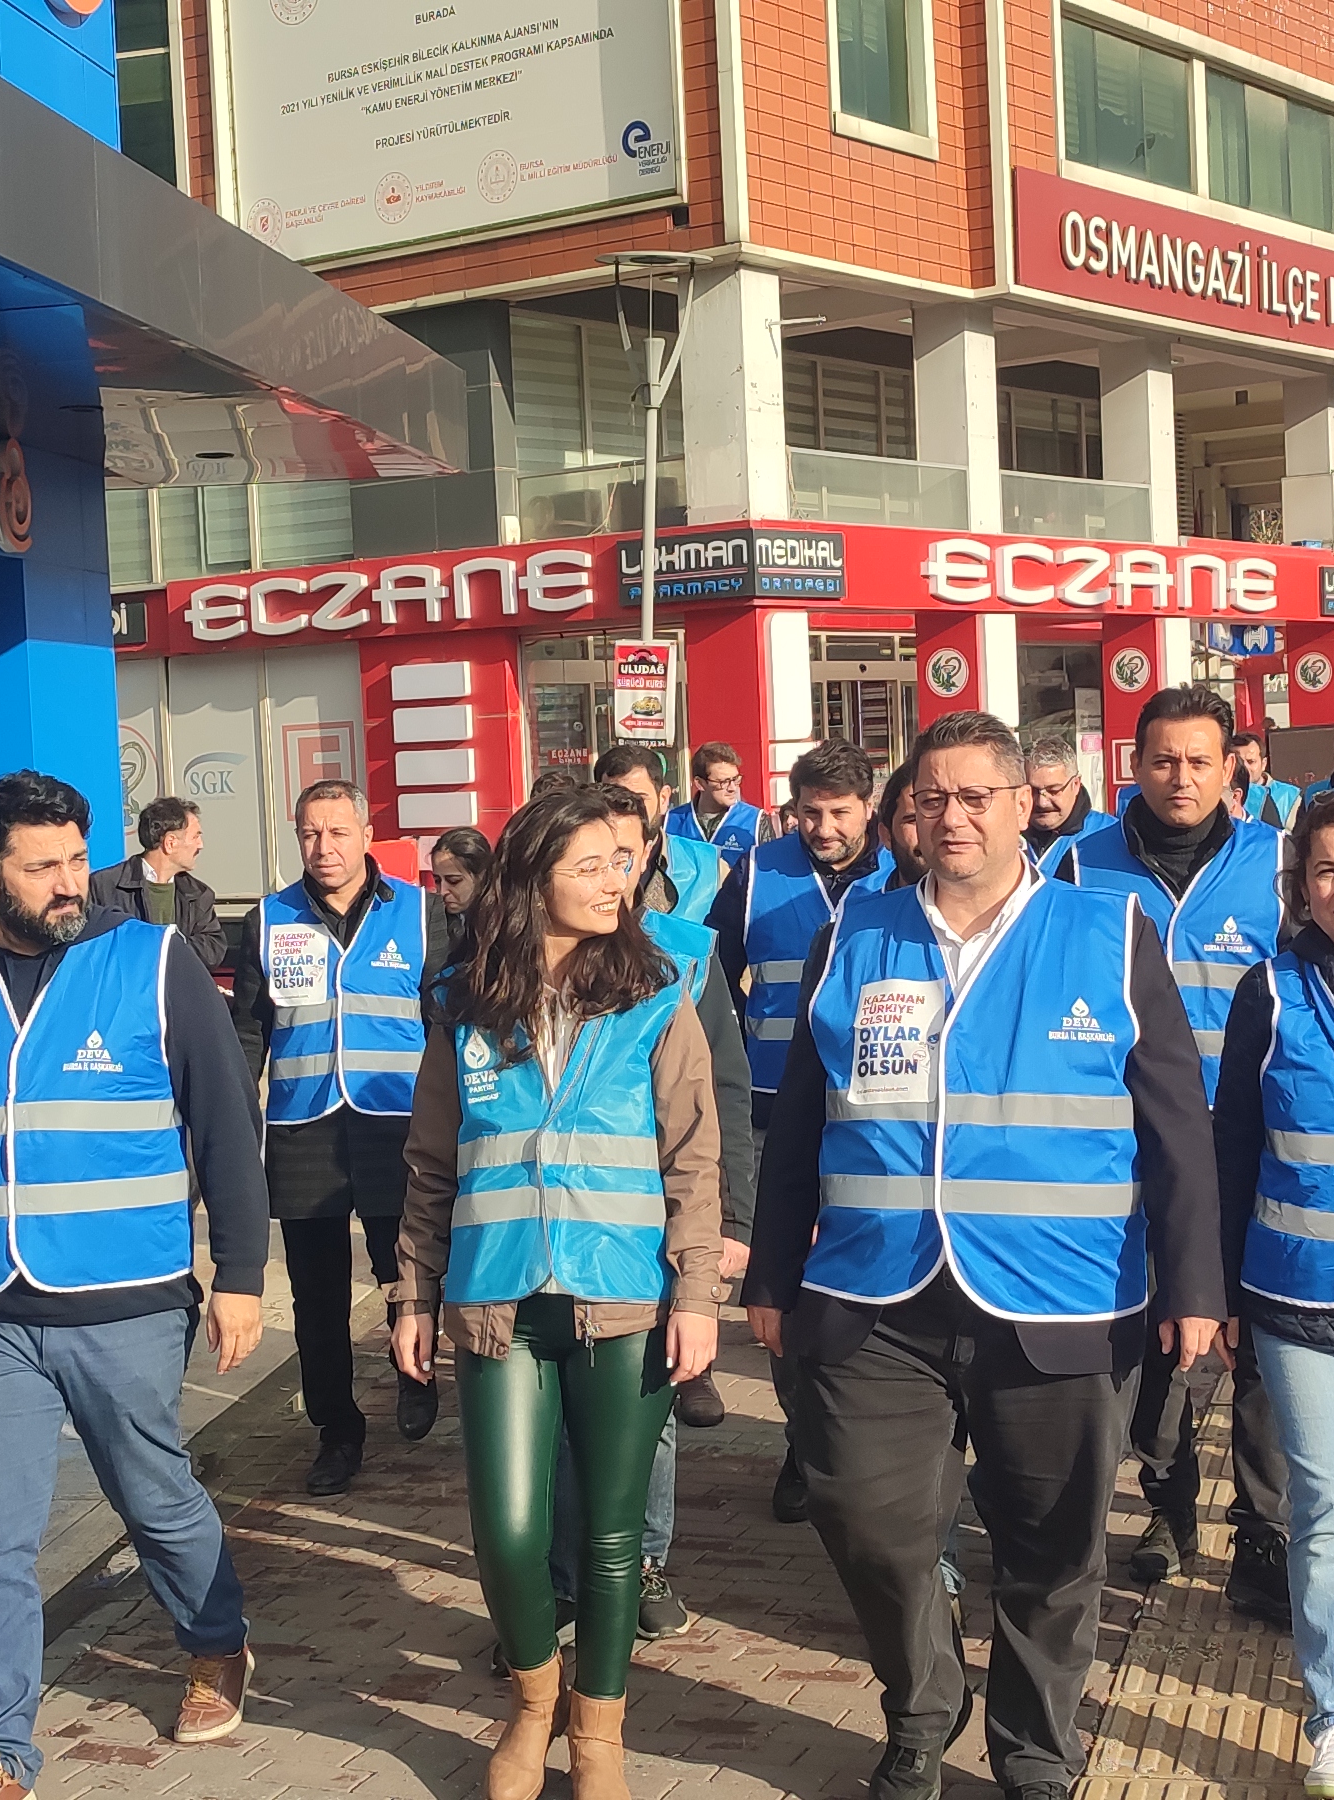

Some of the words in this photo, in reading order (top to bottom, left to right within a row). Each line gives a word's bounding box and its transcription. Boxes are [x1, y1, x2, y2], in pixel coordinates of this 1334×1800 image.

[415, 6, 456, 24] BURADA
[327, 66, 359, 83] BURSA
[361, 53, 410, 75] ESKİŞEHİR
[412, 44, 449, 62] BİLECİK
[452, 33, 502, 53] KALKINMA
[504, 18, 559, 40] AJANSI'NIN
[281, 102, 300, 115] 2021
[302, 97, 318, 110] YILI
[320, 87, 355, 105] YENİLİK
[357, 85, 369, 97] VE
[371, 71, 423, 93] VERİMLİLİK
[425, 63, 448, 79] MALİ
[451, 56, 488, 75] DESTEK
[491, 44, 544, 65] PROGRAMI
[546, 28, 615, 52] KAPSAMINDA
[395, 90, 428, 109] ENERJİ
[431, 80, 472, 99] YÖNETİM
[375, 129, 415, 149] PROJESİ
[1059, 209, 1251, 307] OSMANGAZİ
[1256, 245, 1321, 326] İLÇE
[920, 538, 1278, 613] ECZANE
[184, 549, 594, 642] ECZANE
[620, 663, 665, 675] ULUDAĞ
[189, 769, 236, 795] SGK
[1214, 933, 1242, 943] DEVA
[272, 955, 314, 967] OYLAR
[273, 966, 304, 978] DEVA
[274, 977, 314, 989] OLSUN
[863, 992, 926, 1006] KAZANAN
[860, 1014, 903, 1026] OLSUN
[1062, 1016, 1101, 1028] DEVA
[859, 1025, 921, 1043] OYLAR
[77, 1048, 111, 1060] DEVA
[858, 1042, 905, 1060] DEVA
[857, 1058, 919, 1078] OLSUN
[463, 1068, 499, 1087] DEVA
